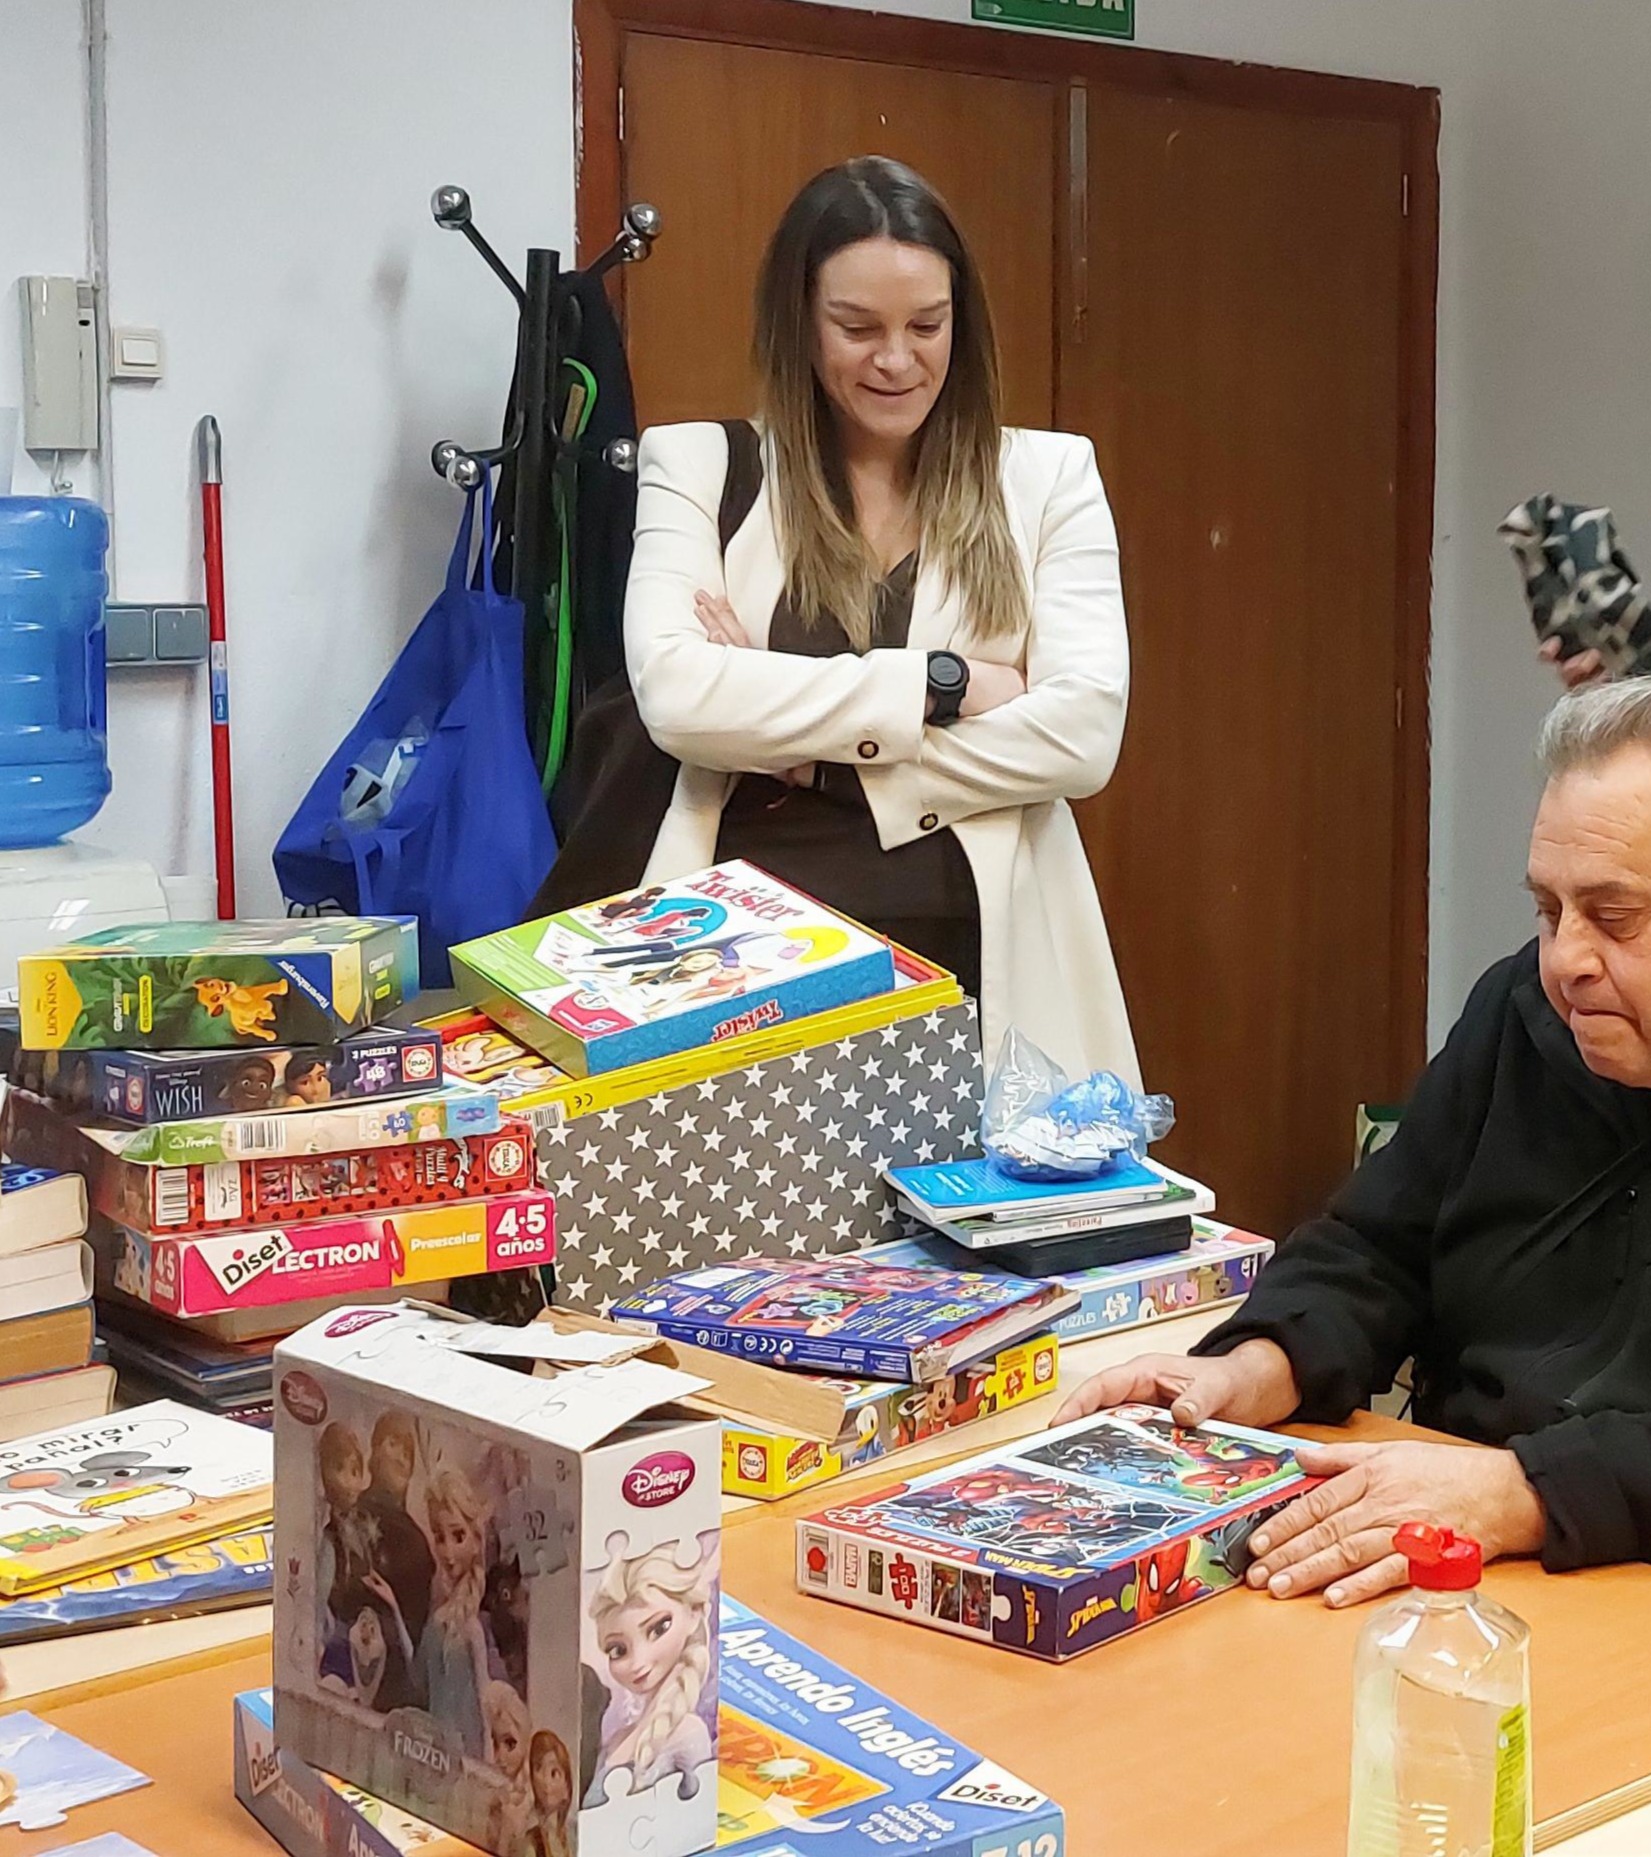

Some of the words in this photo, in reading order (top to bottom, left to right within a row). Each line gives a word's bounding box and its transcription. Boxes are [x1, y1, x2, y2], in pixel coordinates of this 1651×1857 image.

[685, 870, 804, 921] Twister
[45, 972, 58, 1004] KING
[277, 960, 330, 1010] Ravensburger
[46, 1007, 58, 1037] LION
[711, 999, 784, 1042] Twister
[359, 1046, 397, 1059] PUZZLES
[366, 1067, 386, 1081] 48
[155, 1085, 203, 1117] WISH
[410, 1230, 482, 1252] Preescolar
[496, 1237, 546, 1258] años
[221, 1234, 287, 1287] Diset
[38, 1423, 140, 1450] mirar
[4, 1436, 123, 1470] pañal?
[644, 1486, 676, 1502] STORE
[523, 1510, 548, 1540] 32
[865, 1527, 953, 1553] PUZZLES
[845, 1543, 857, 1588] MARVEL
[899, 1568, 910, 1595] 100
[719, 1628, 856, 1713] Aprendo
[837, 1706, 956, 1777] Inglés
[394, 1730, 450, 1773] FROZEN
[951, 1783, 1039, 1808] Diset
